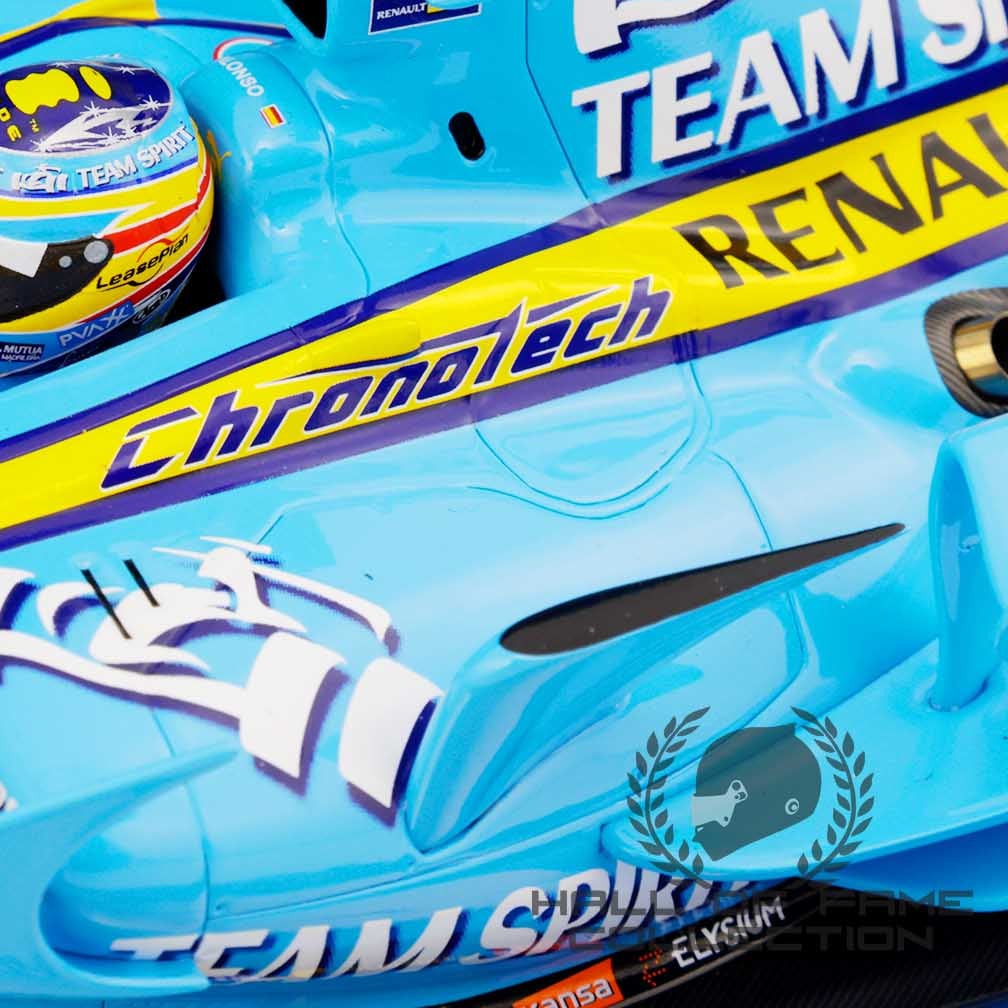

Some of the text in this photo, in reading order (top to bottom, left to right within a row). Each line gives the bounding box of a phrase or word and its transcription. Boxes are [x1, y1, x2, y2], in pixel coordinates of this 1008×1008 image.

[376, 2, 427, 20] RENAULT
[77, 124, 196, 189] TEAM SPIRIT
[3, 344, 42, 355] MUTUA
[672, 895, 786, 969] ELYSIUM
[519, 978, 614, 1008] ansa
